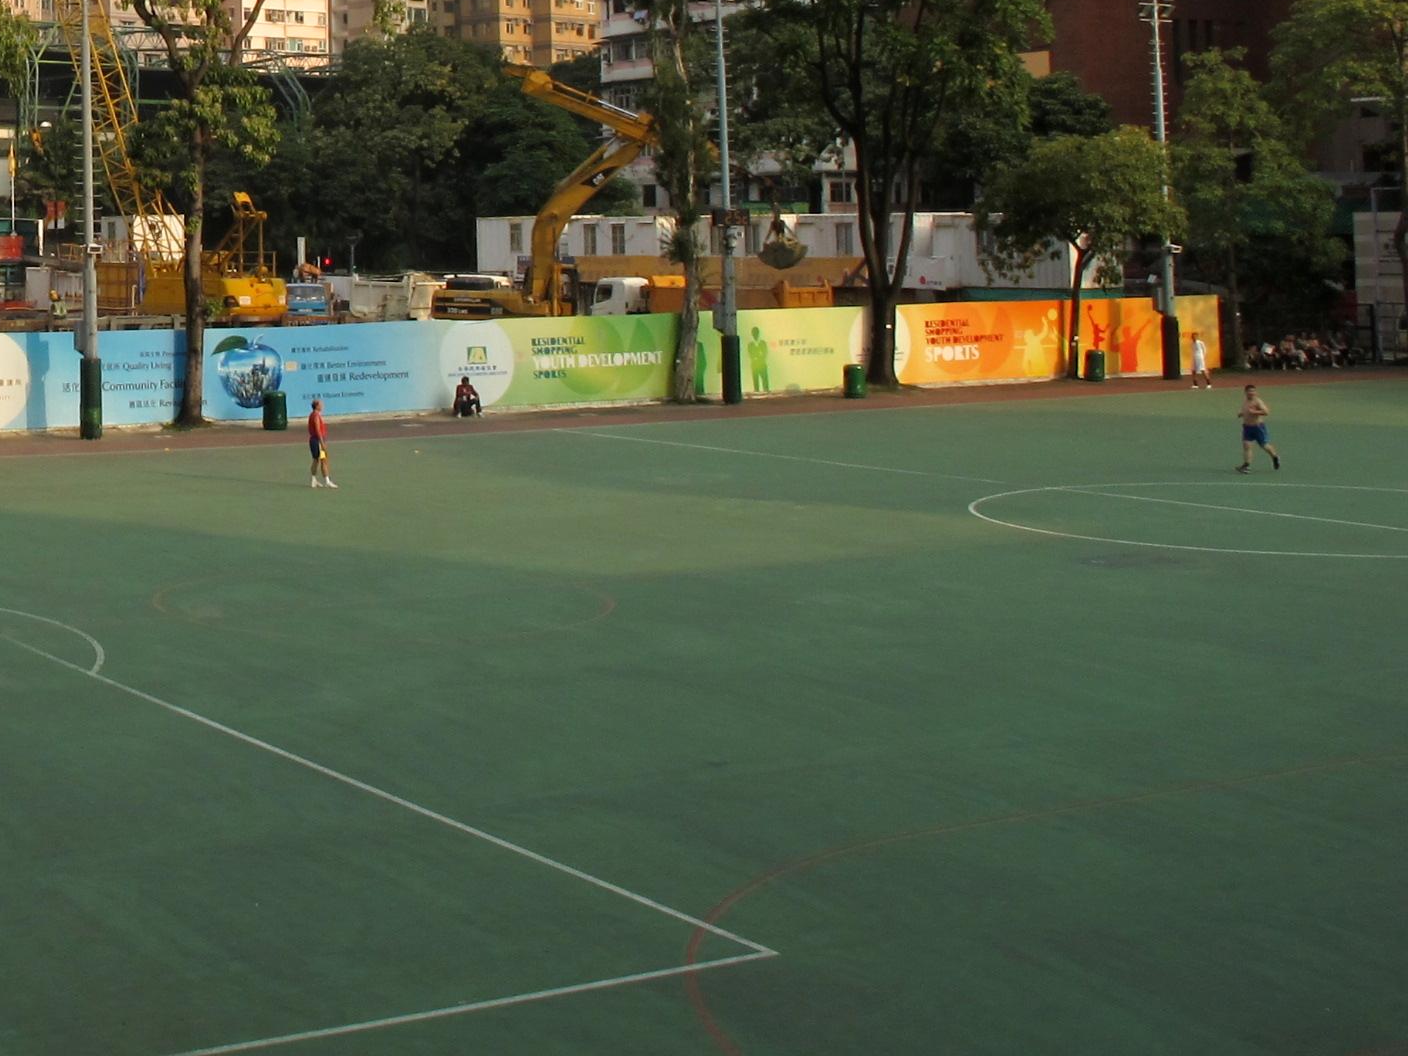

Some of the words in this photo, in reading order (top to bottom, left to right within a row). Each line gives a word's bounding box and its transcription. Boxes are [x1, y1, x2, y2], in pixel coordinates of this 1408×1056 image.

[925, 319, 969, 328] RESIDENTIAL
[925, 328, 963, 336] SHOPPING
[531, 337, 585, 346] RESIDENTIAL
[926, 335, 951, 345] YOUTH
[953, 334, 1004, 343] DEVELOPMENT
[531, 346, 577, 355] SHOPPING
[925, 344, 980, 362] SPORTS
[532, 354, 576, 370] YOUTH
[578, 351, 663, 368] DEVELOPMENT
[122, 362, 149, 372] Quality
[150, 361, 172, 371] Living
[349, 370, 409, 382] Redevelopment
[533, 370, 567, 379] SPORTS
[102, 380, 157, 392] Community
